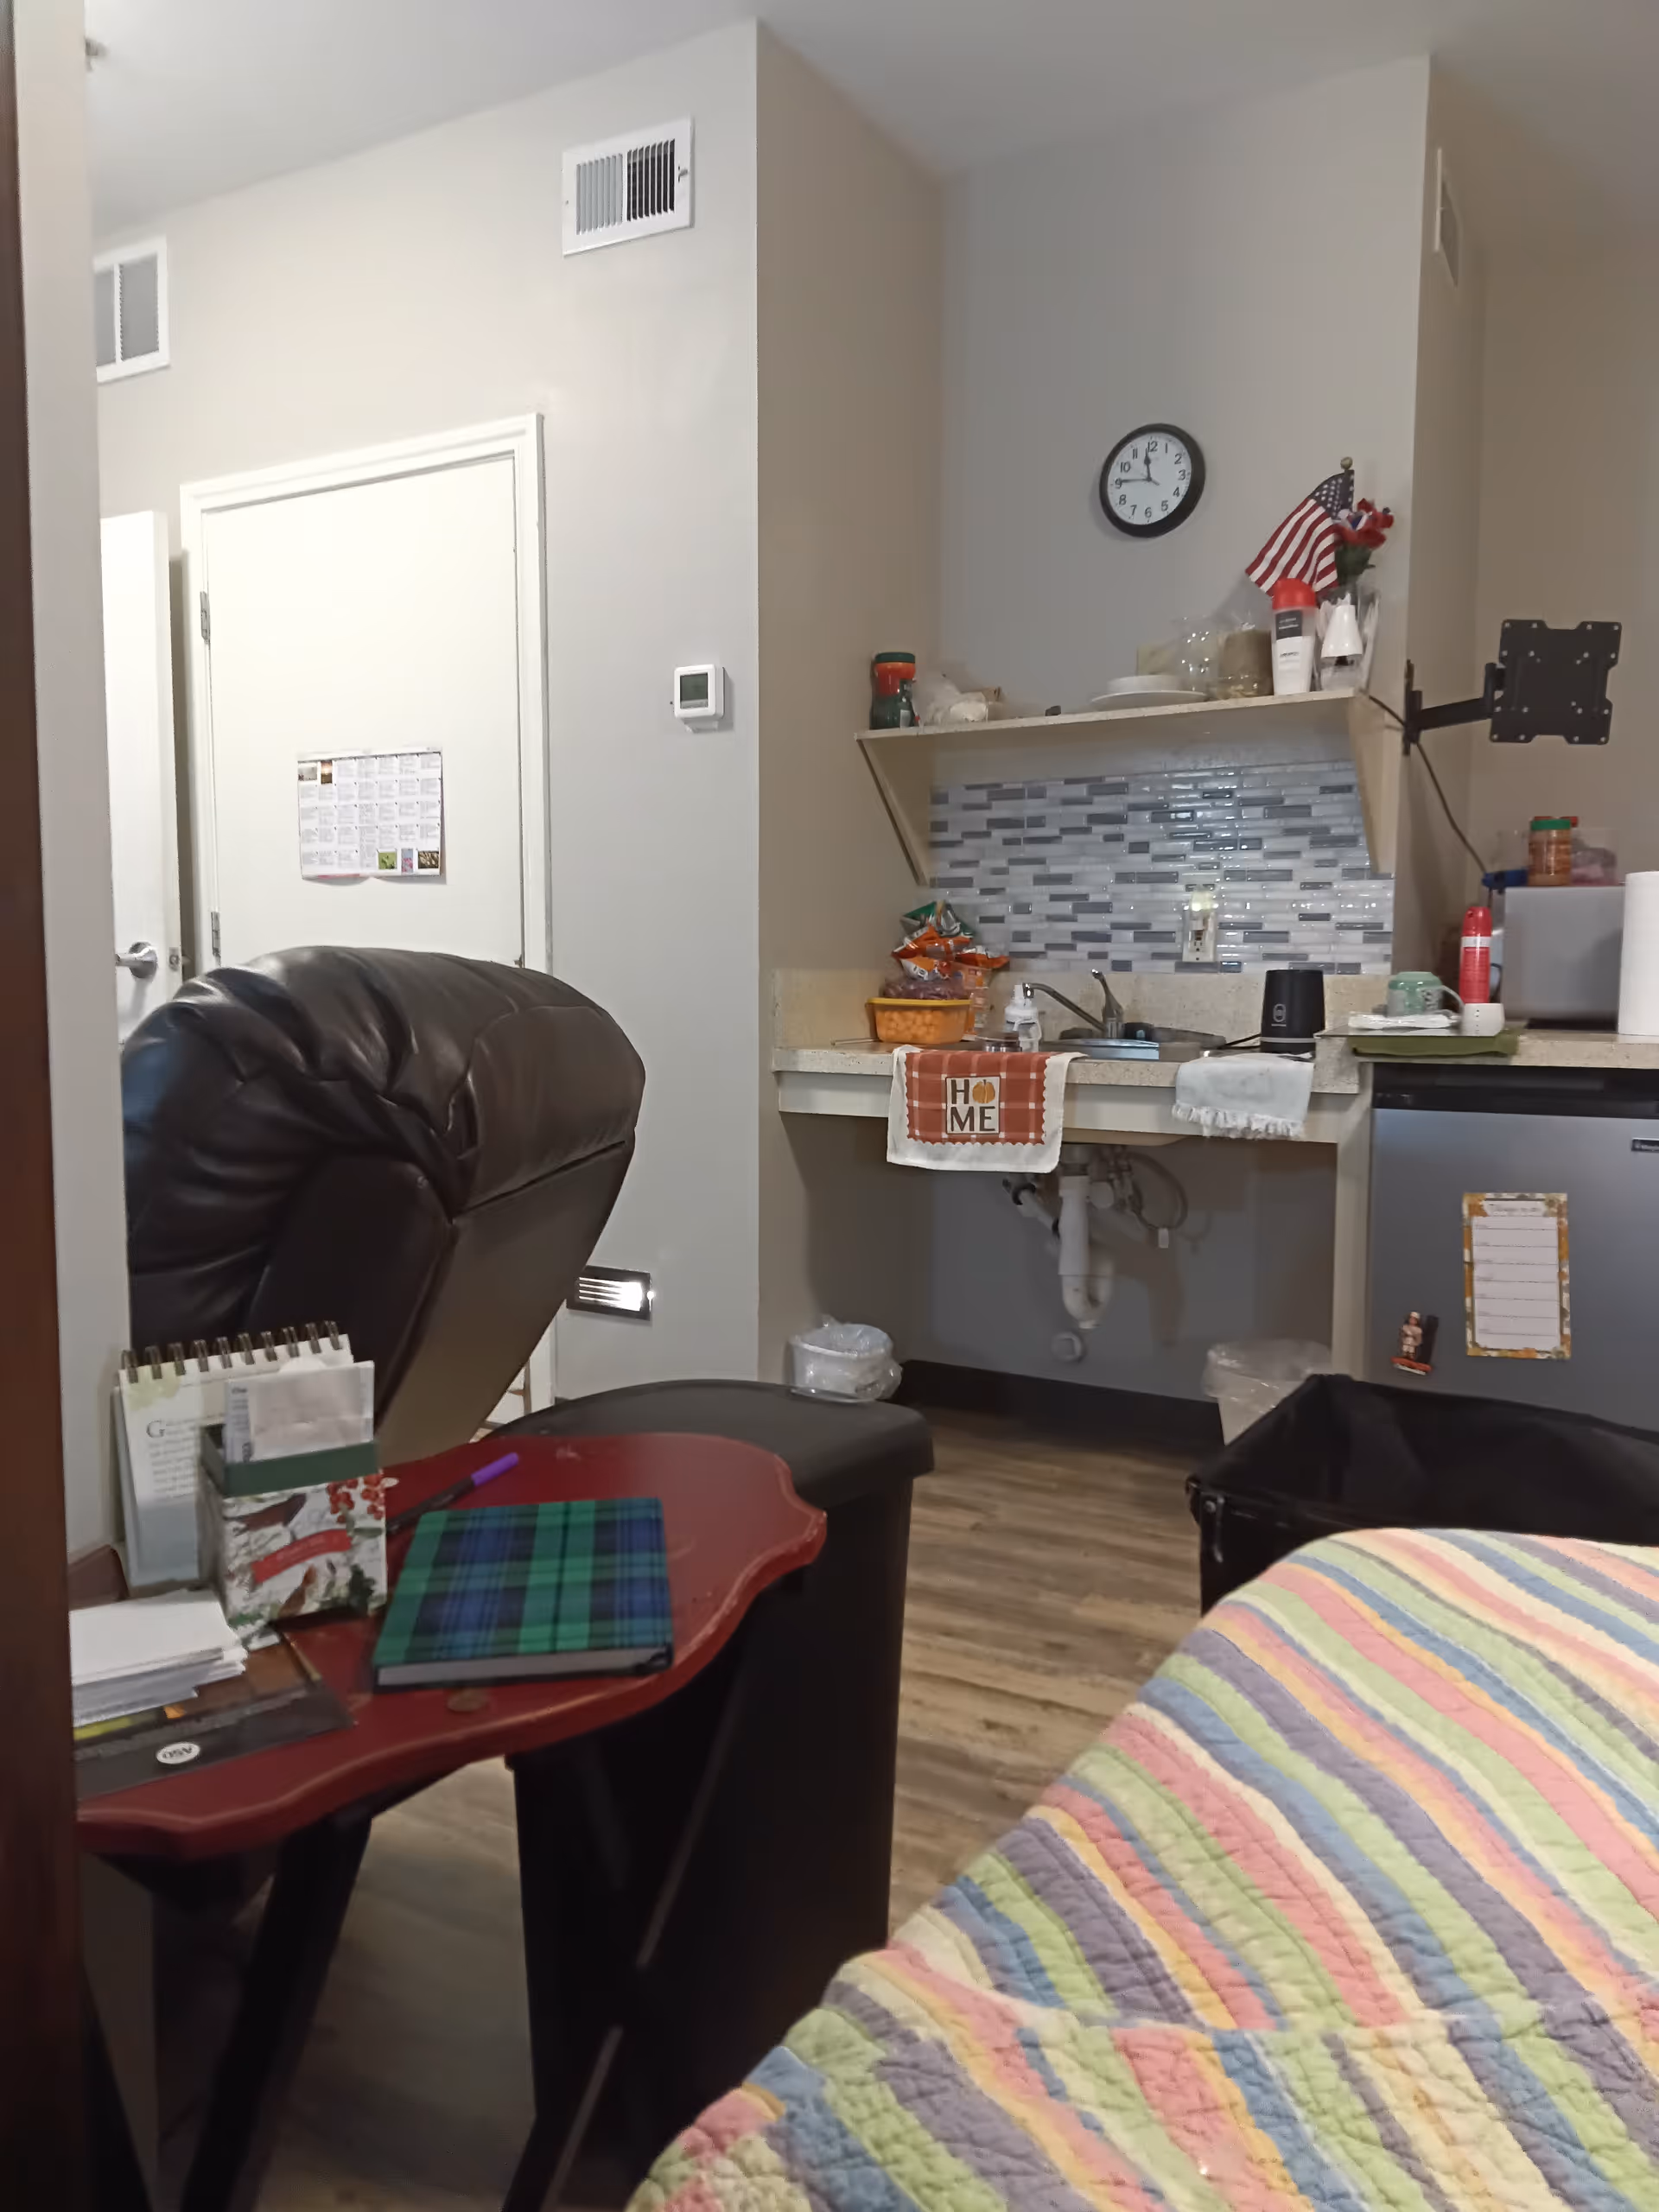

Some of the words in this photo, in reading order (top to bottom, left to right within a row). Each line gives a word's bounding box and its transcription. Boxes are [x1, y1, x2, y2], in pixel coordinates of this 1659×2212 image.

[1147, 441, 1158, 453] 12
[1132, 448, 1138, 460] 11
[1174, 453, 1183, 465] 2
[1120, 461, 1131, 473] 10
[1178, 469, 1186, 480] 3
[1115, 478, 1122, 489] 9
[1173, 486, 1180, 497] 4
[1119, 494, 1127, 505] 8
[1160, 499, 1169, 512] 5
[1130, 504, 1137, 516] 7
[1144, 506, 1152, 518] 6
[950, 1106, 995, 1132] ME
